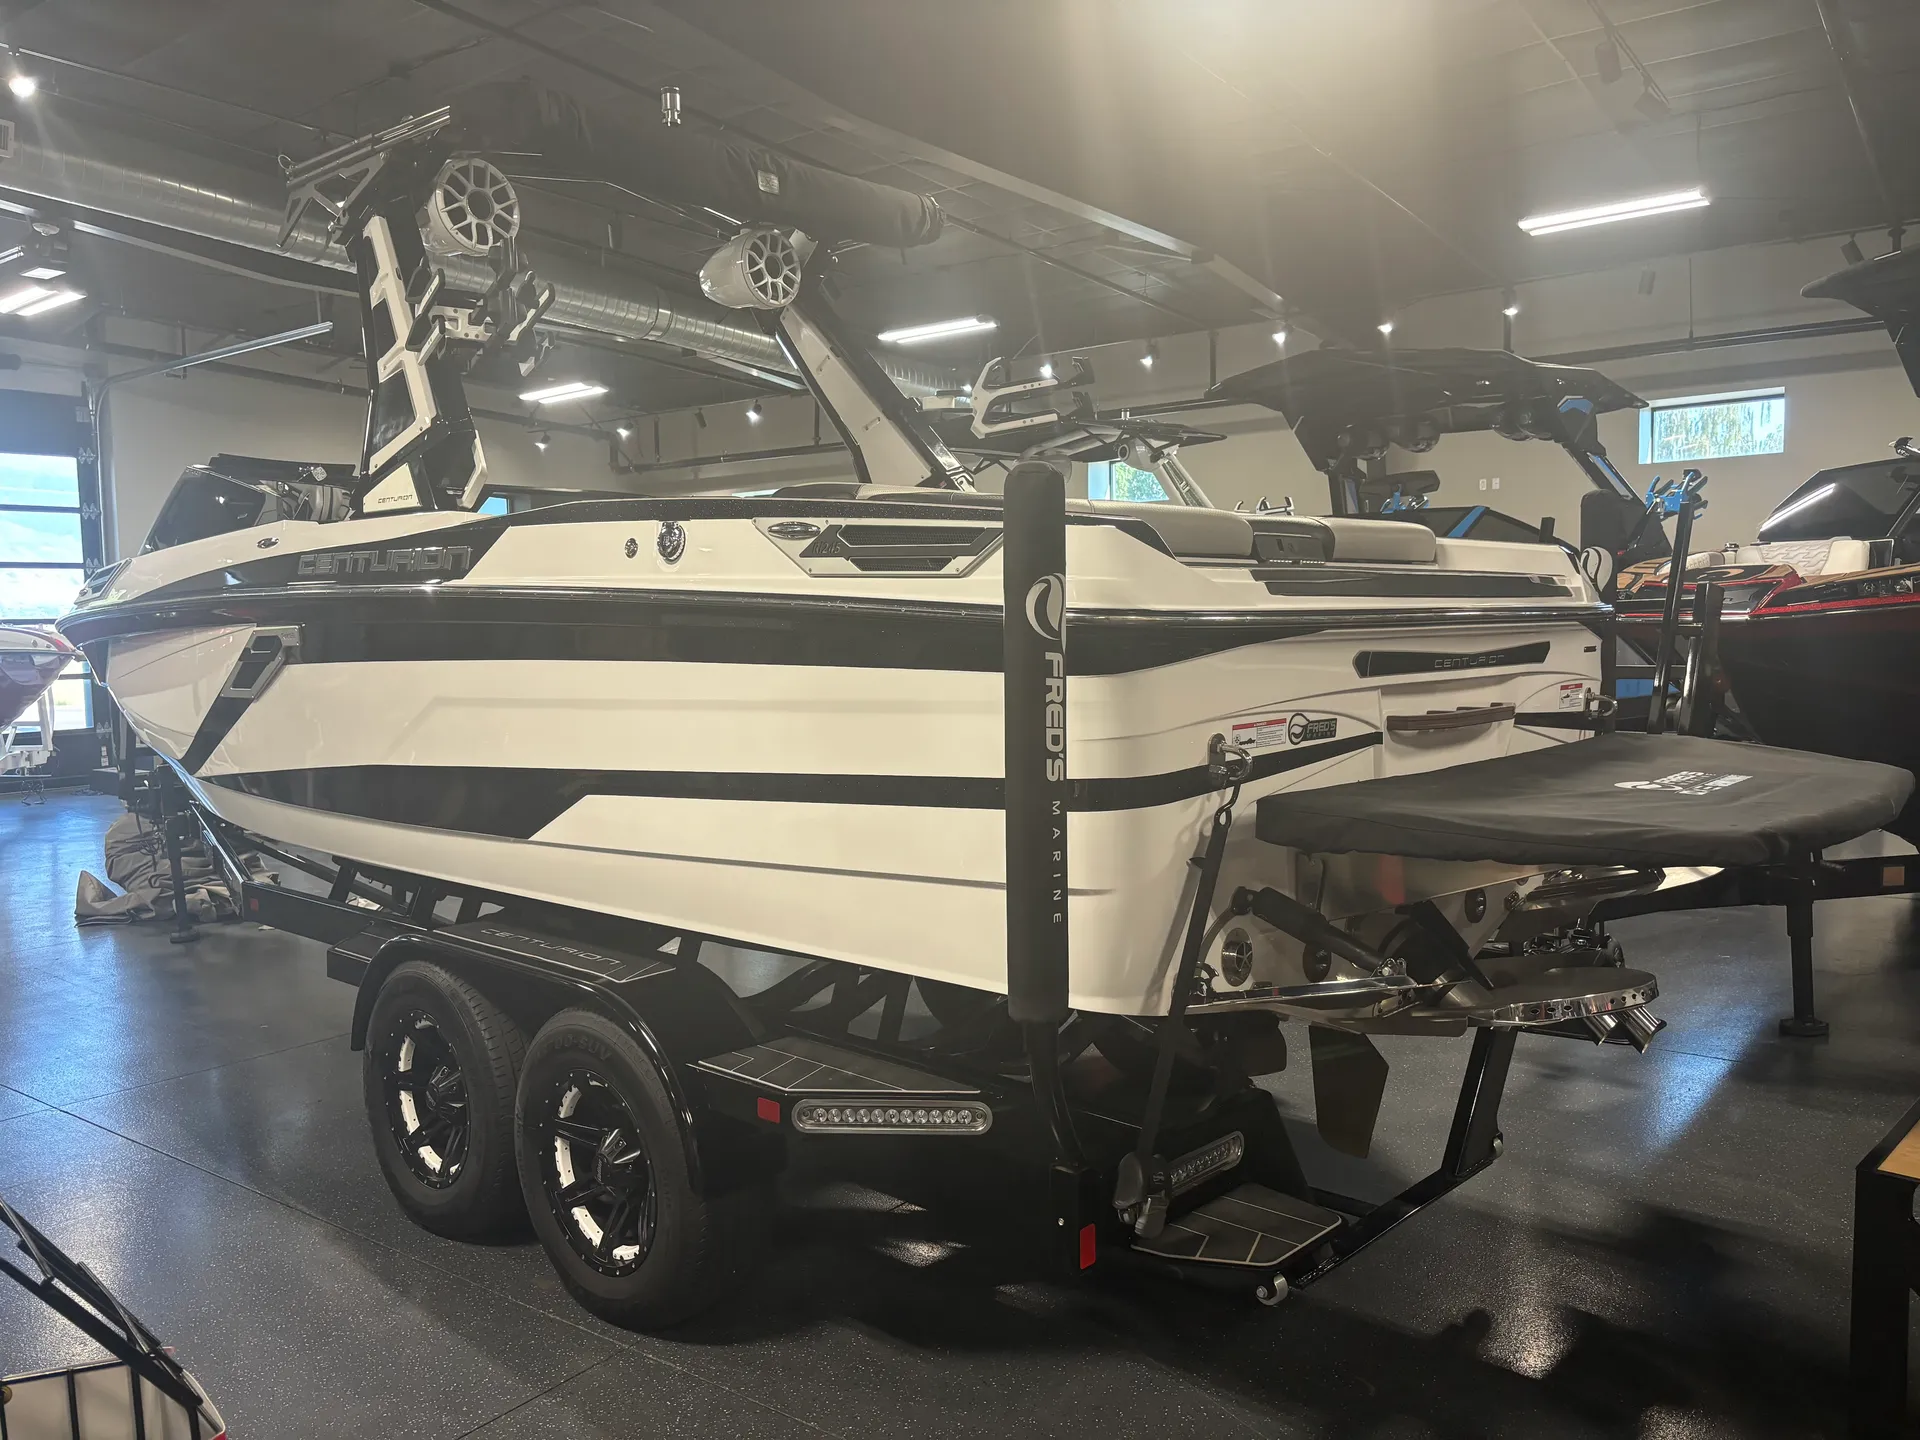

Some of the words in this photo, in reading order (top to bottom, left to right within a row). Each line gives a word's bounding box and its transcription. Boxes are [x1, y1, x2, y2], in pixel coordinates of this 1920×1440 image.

[298, 546, 471, 575] CENTURION
[1044, 651, 1064, 782] FRED'S
[1306, 720, 1336, 734] FRED'S
[1052, 800, 1062, 924] MARINE
[480, 928, 621, 966] CENTURION
